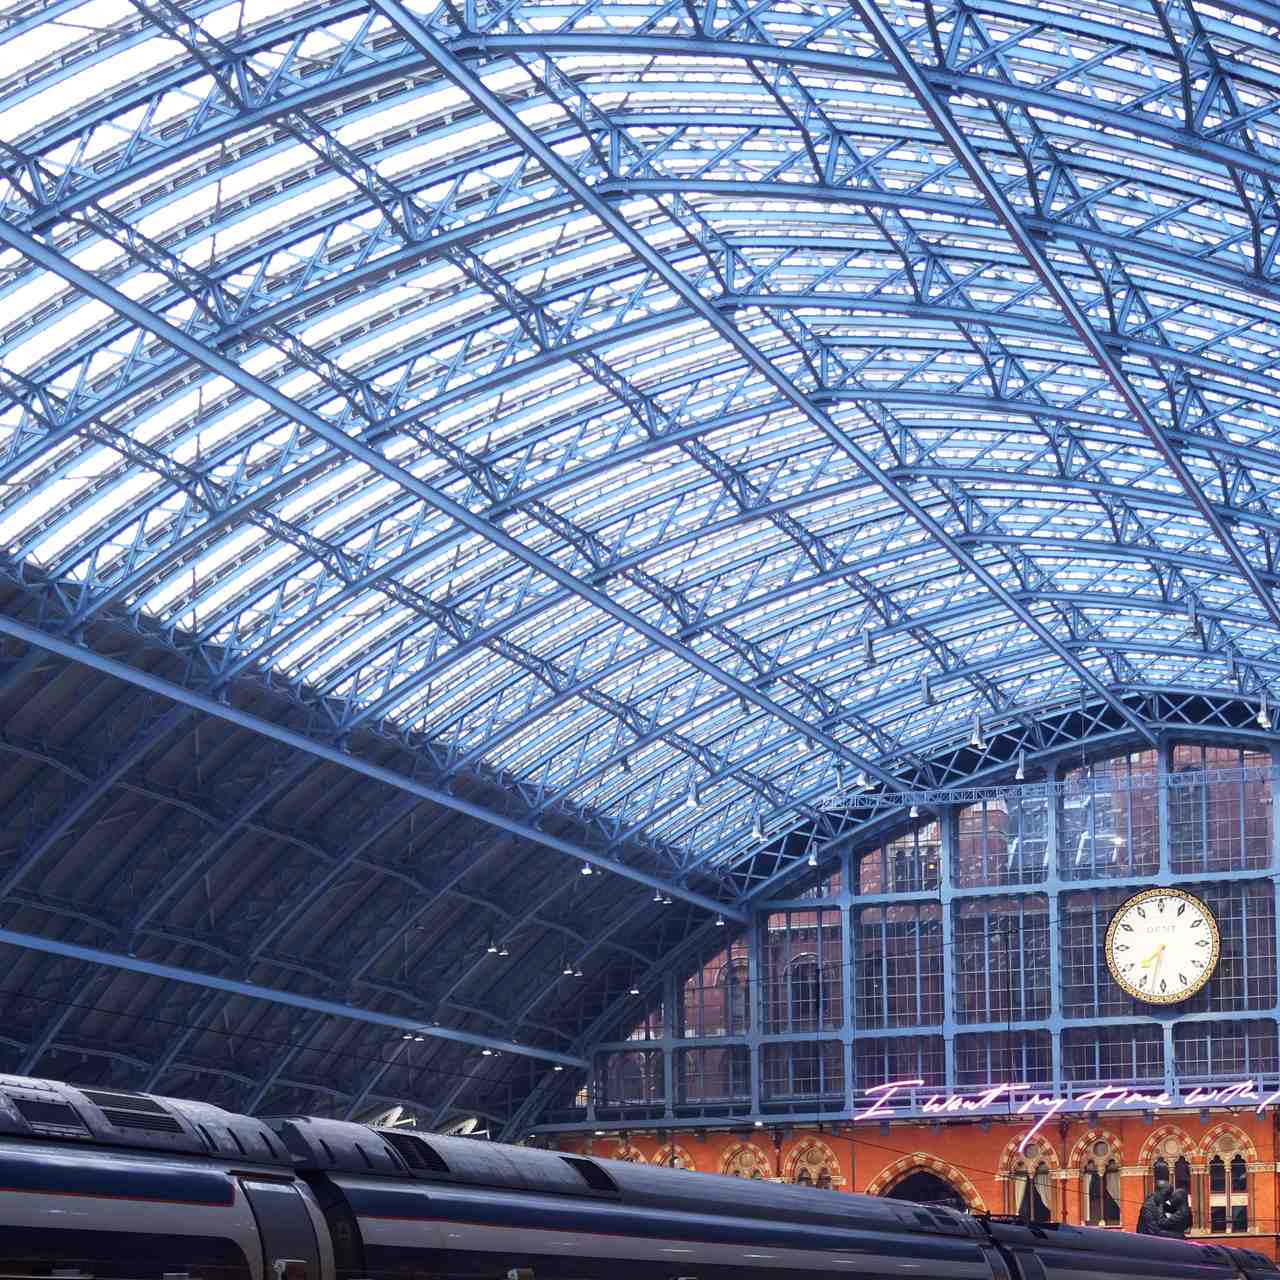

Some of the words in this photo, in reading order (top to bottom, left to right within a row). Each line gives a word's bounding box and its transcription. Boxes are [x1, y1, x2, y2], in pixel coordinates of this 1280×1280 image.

[1146, 925, 1176, 934] DENT
[854, 1079, 924, 1121] I
[922, 1082, 1030, 1113] want
[1017, 1094, 1066, 1153] my
[1184, 1079, 1259, 1104] with
